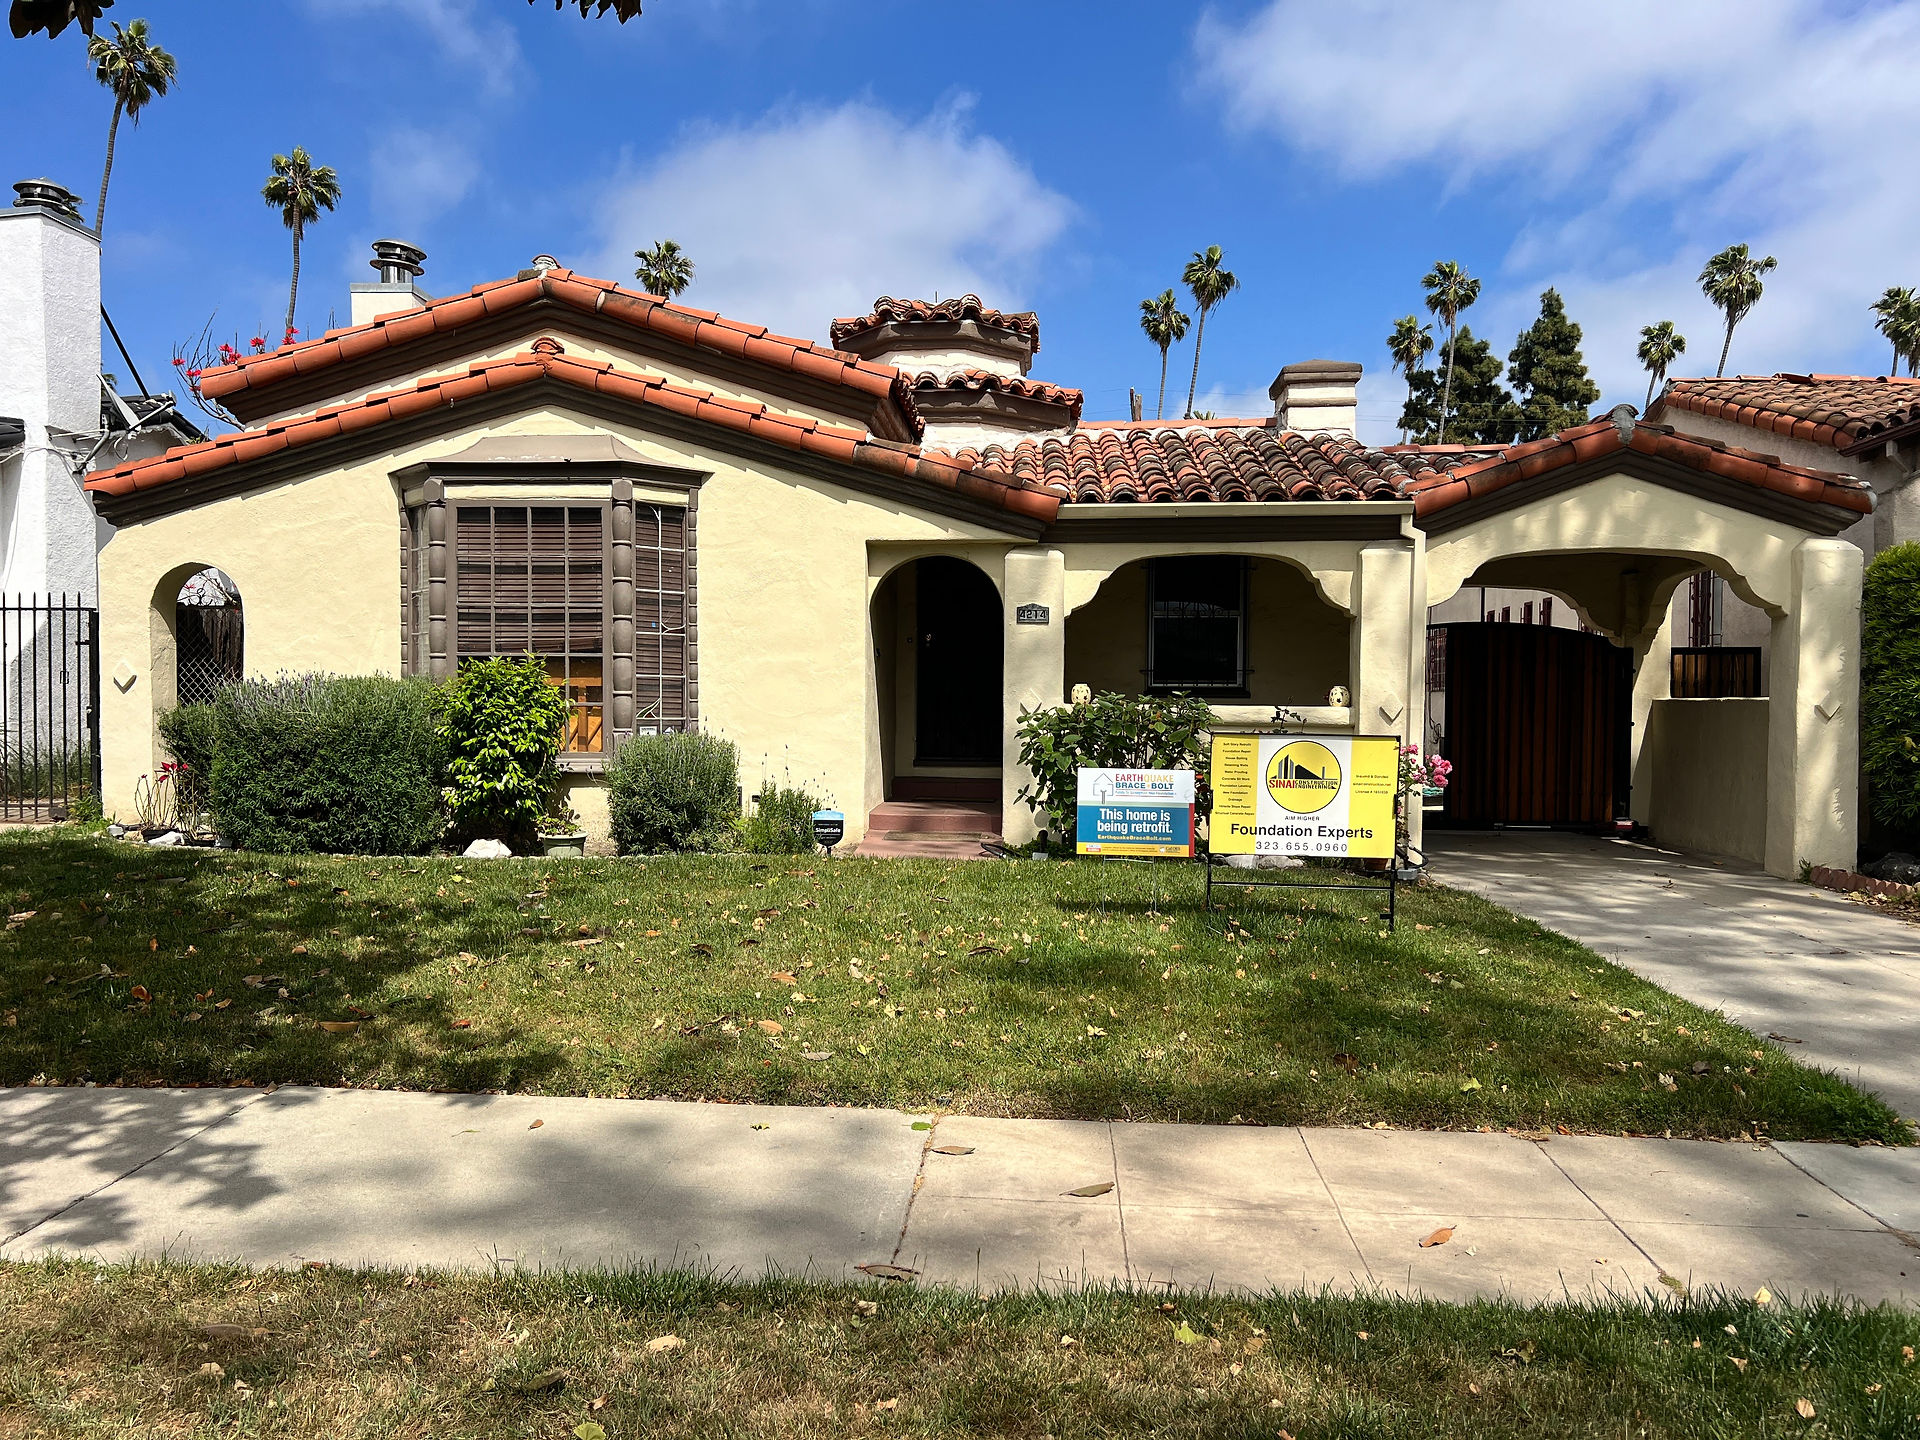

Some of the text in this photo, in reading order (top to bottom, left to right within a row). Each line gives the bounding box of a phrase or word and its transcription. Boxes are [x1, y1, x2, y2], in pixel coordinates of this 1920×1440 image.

[1020, 610, 1046, 618] 4214
[1115, 773, 1174, 782] EARTHQUAKE
[1268, 779, 1295, 789] SINAI
[1099, 808, 1170, 821] This home is
[1097, 820, 1173, 834] being retrofit.
[1230, 823, 1373, 840] Foundation Experts
[1256, 841, 1348, 852] 323.655.0960
